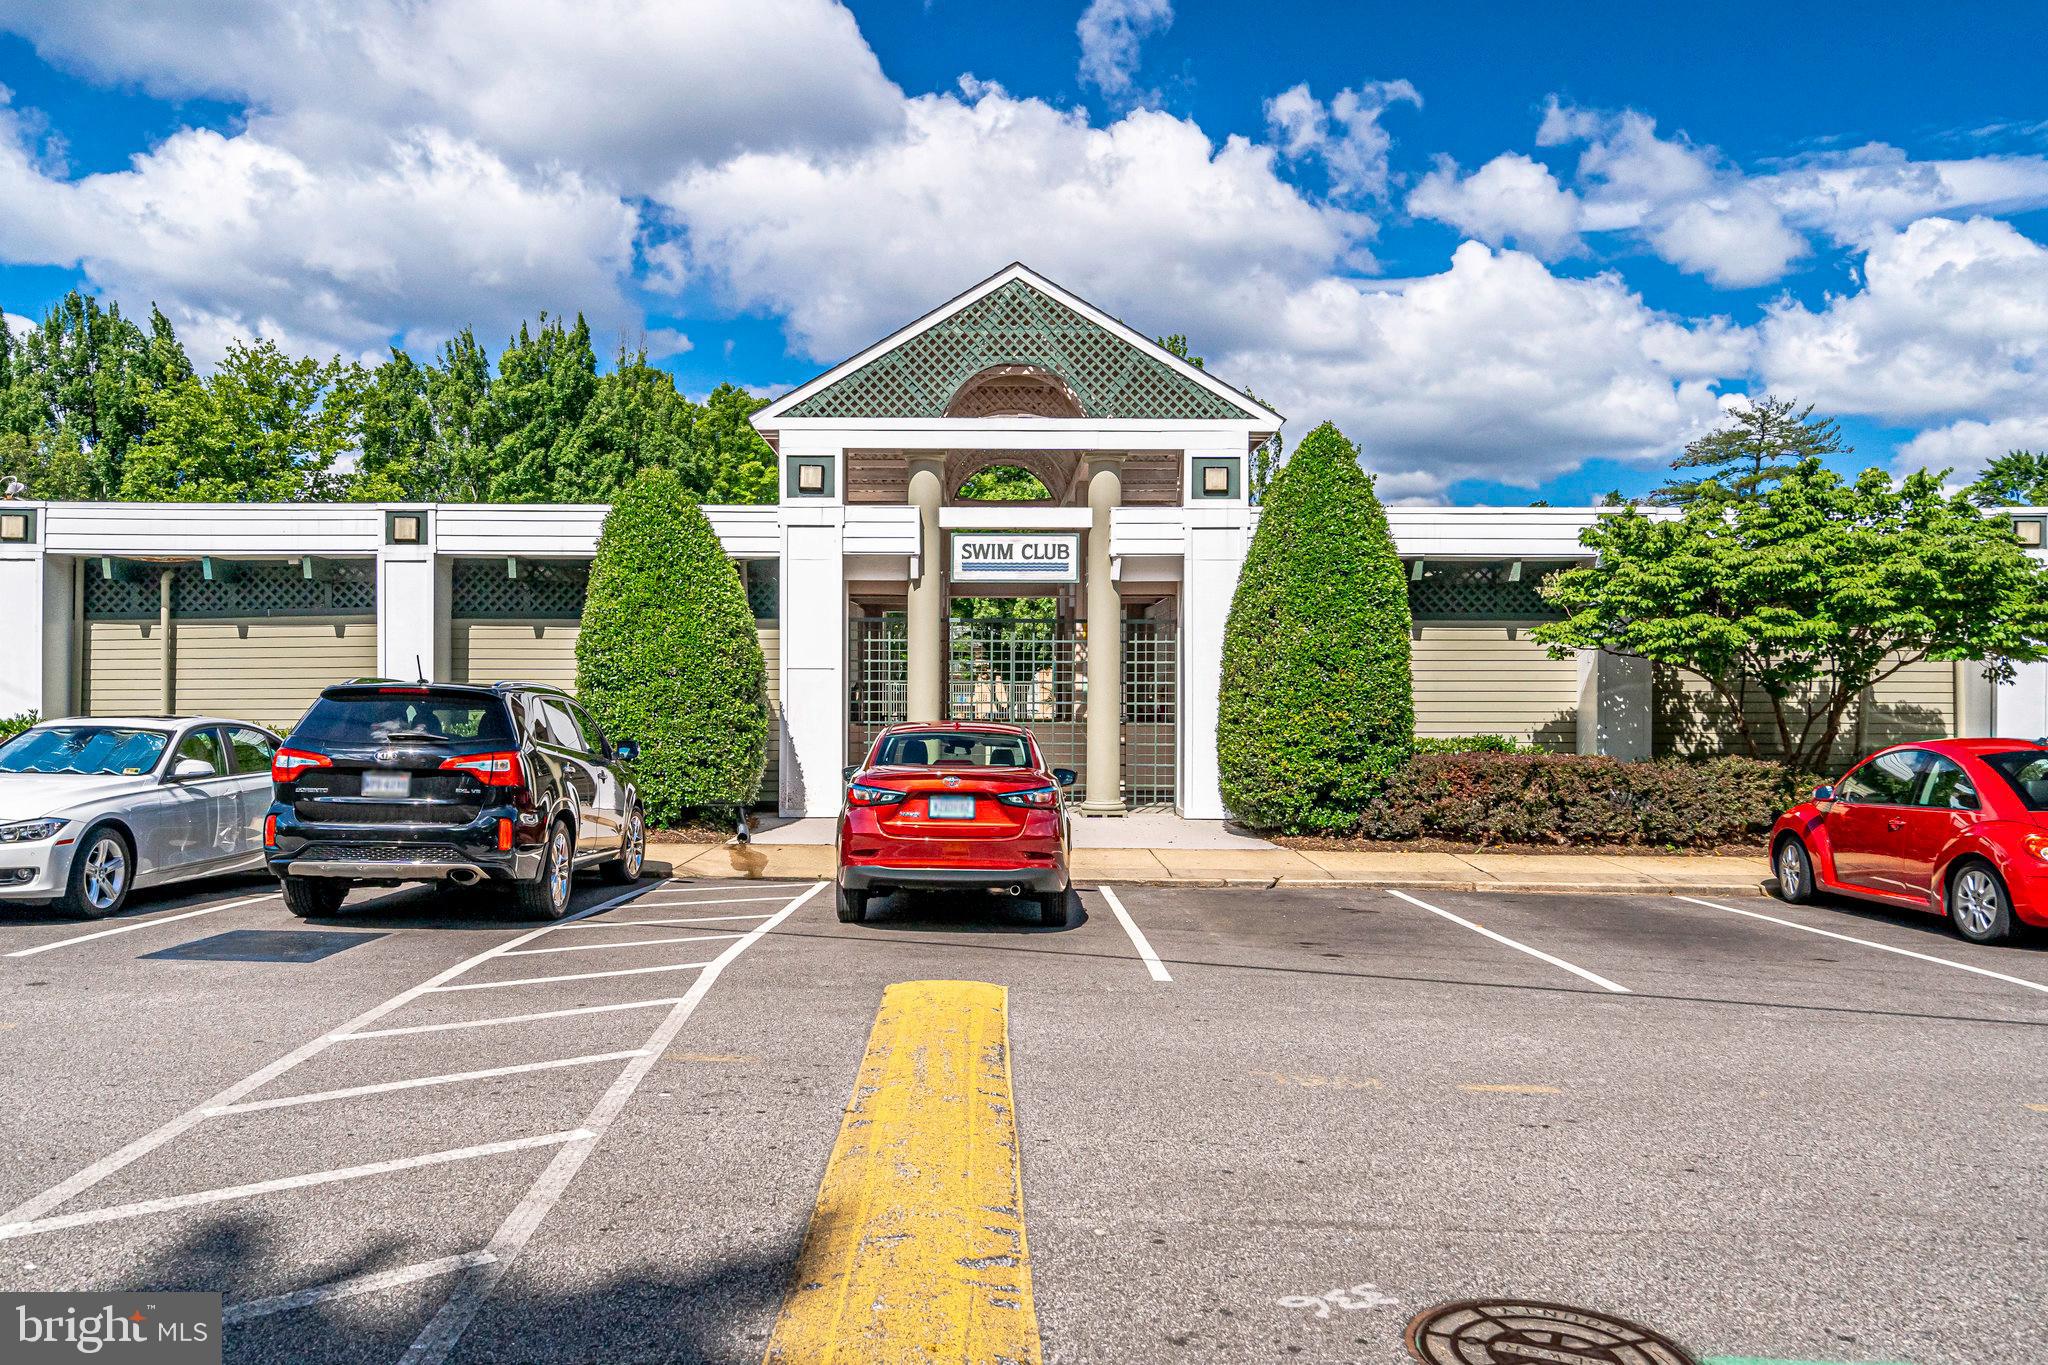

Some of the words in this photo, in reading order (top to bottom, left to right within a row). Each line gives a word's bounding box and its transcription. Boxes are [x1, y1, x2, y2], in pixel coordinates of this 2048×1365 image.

[961, 543, 1014, 560] SWIM
[1021, 543, 1070, 560] CLUB
[1501, 1306, 1624, 1334] COUNTY
